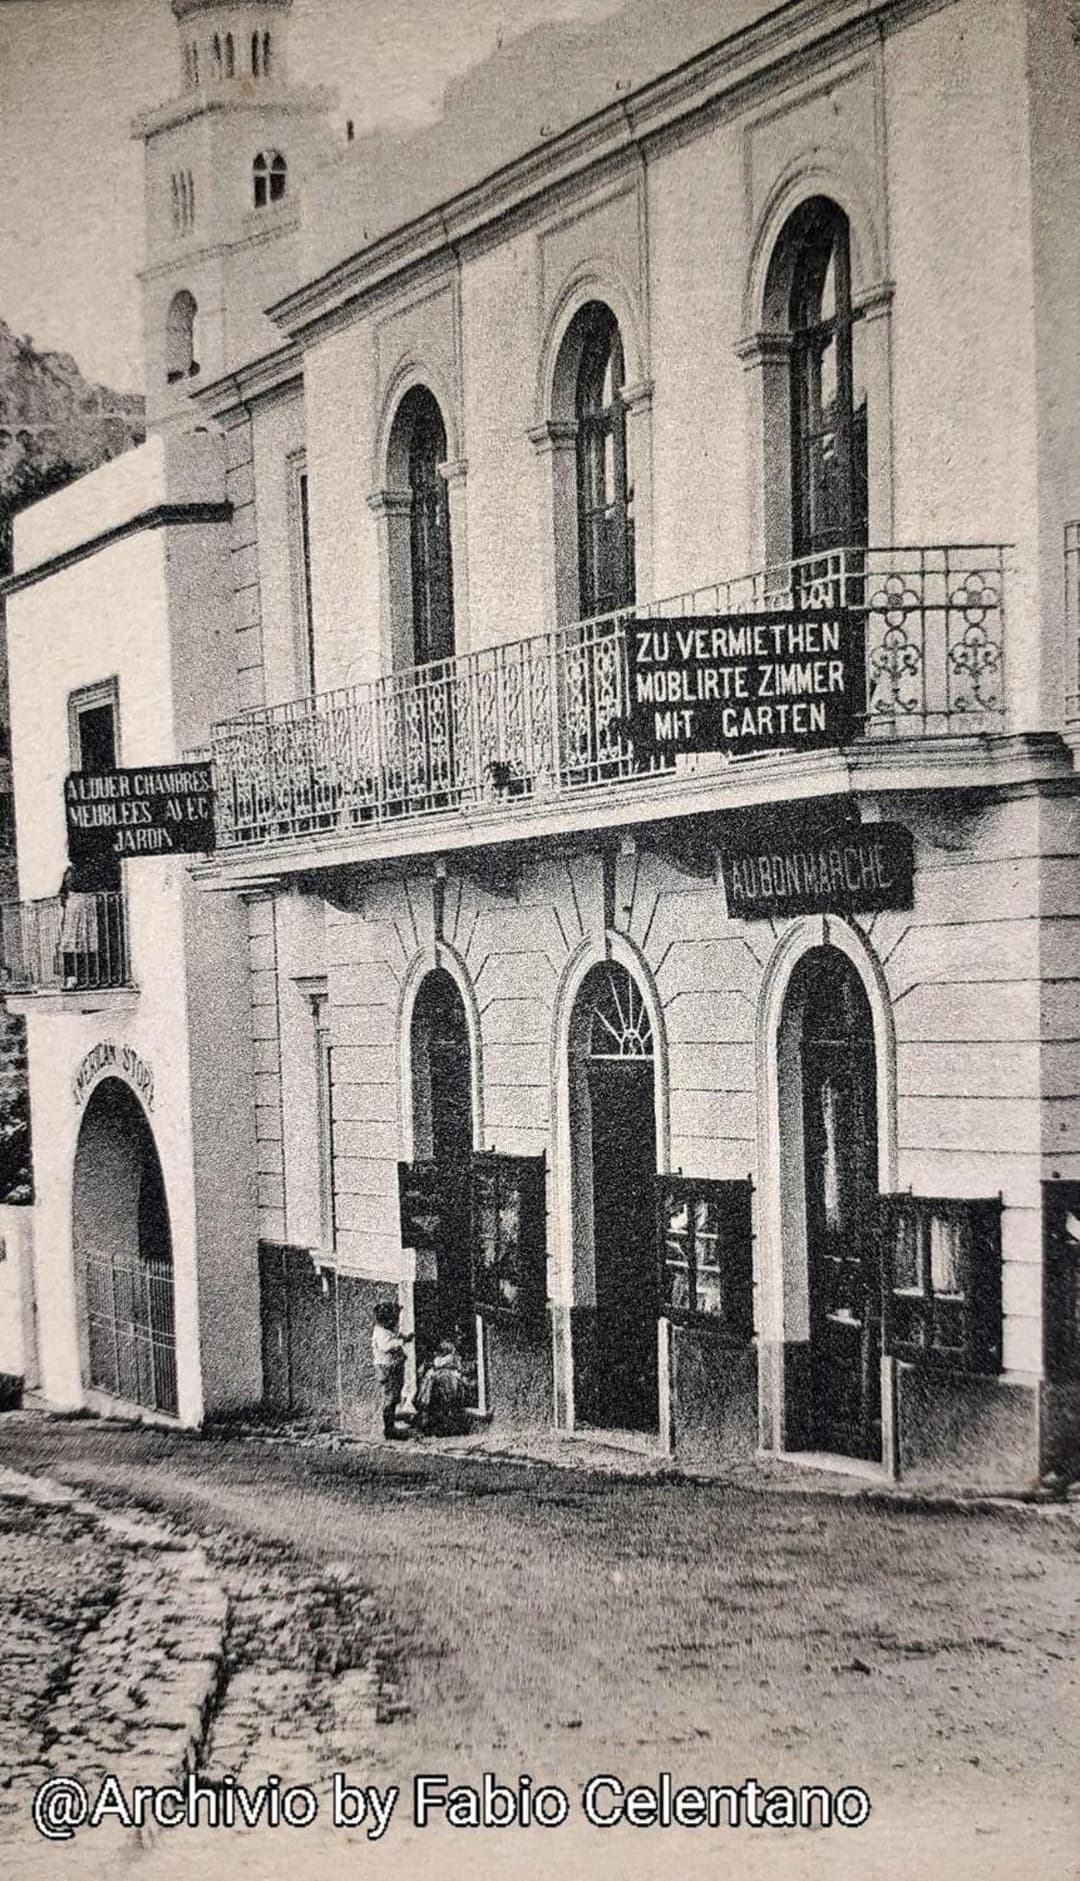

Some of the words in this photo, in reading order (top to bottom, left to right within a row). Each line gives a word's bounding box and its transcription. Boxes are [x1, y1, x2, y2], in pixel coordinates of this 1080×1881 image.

[636, 631, 669, 662] ZU
[676, 621, 840, 661] VERMIETHEN
[758, 660, 844, 697] ZIMMER
[654, 709, 694, 741] MIT
[722, 702, 826, 738] GARTEN
[80, 775, 131, 800] LOUER
[134, 770, 210, 796] CHAMBRES
[166, 797, 209, 822] AVEC
